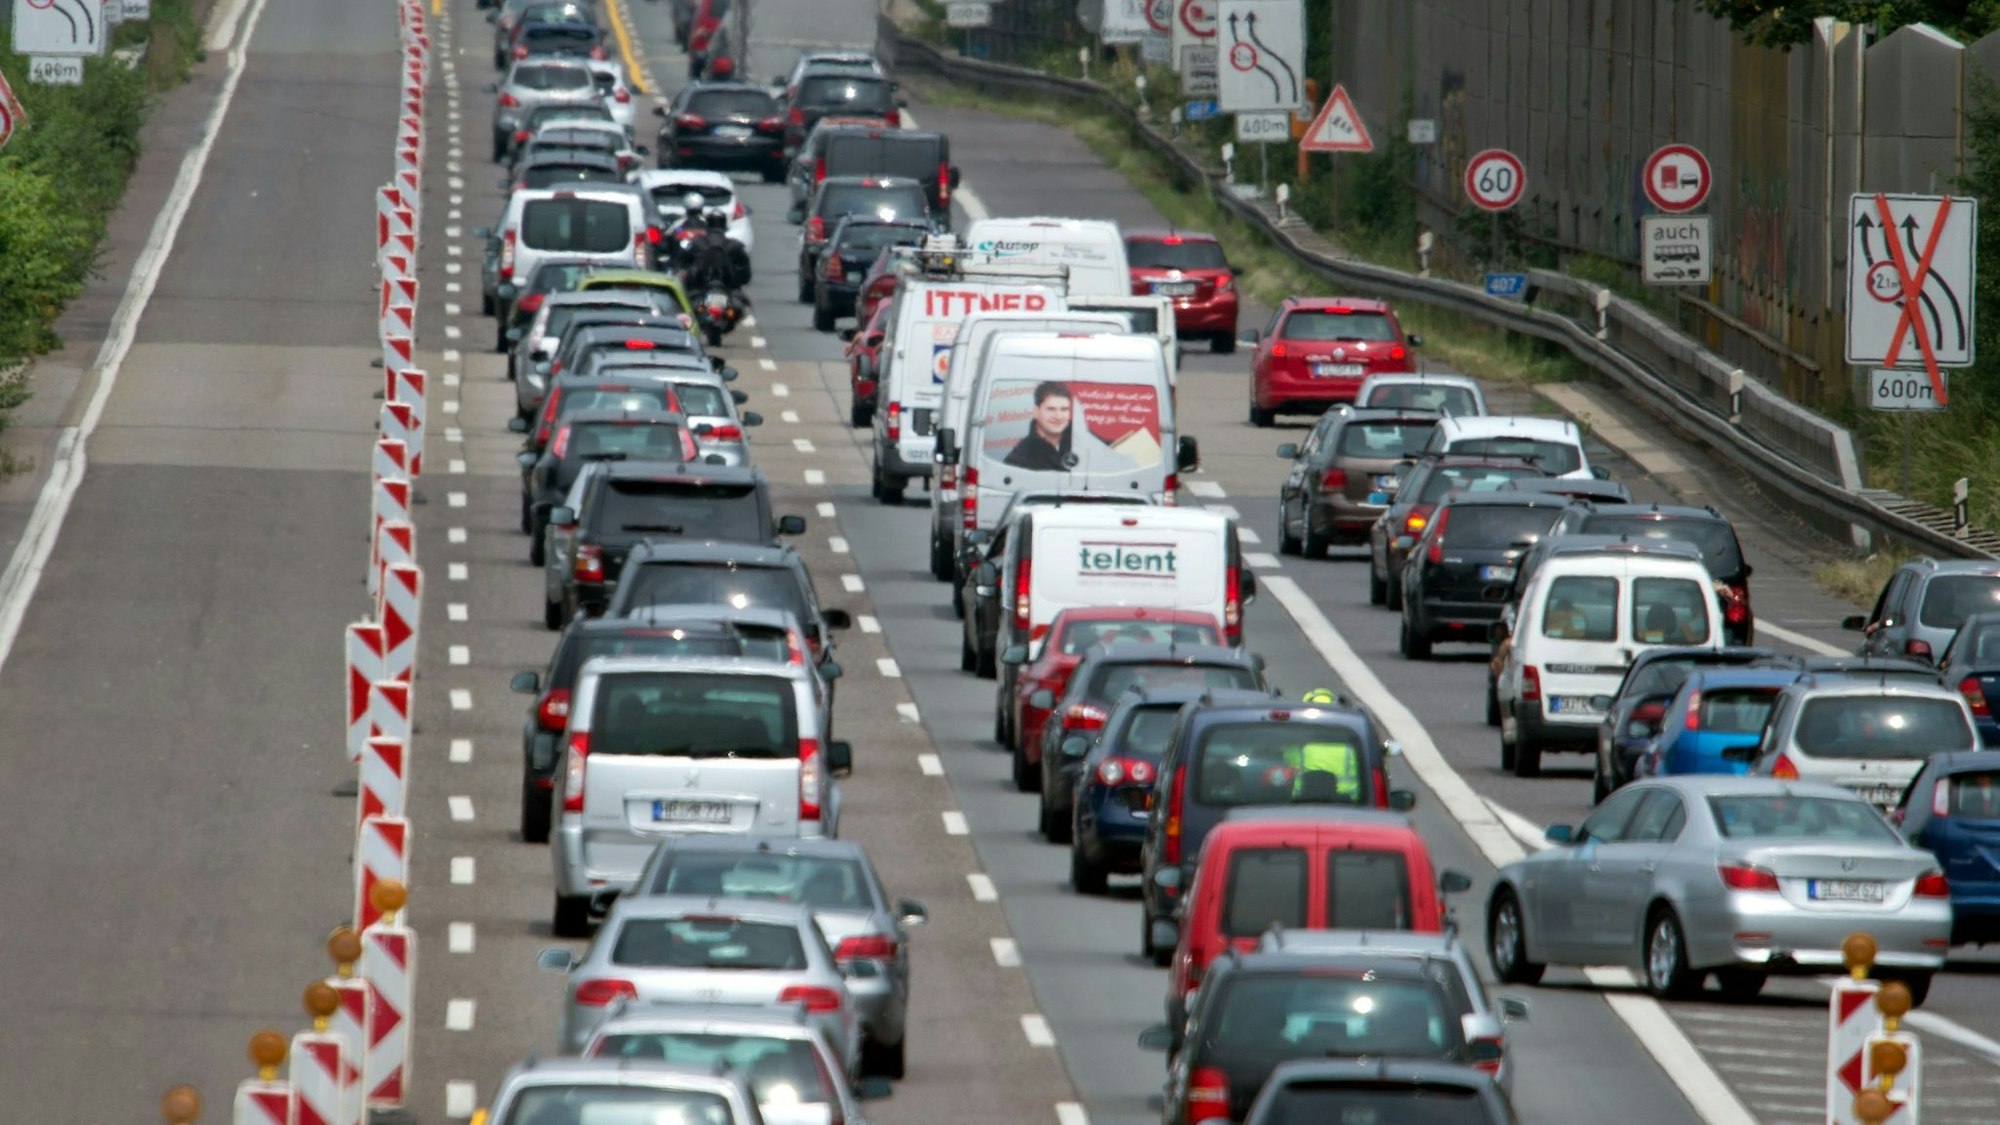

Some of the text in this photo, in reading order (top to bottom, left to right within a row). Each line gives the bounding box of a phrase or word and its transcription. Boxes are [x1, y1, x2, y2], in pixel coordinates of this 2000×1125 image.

[1242, 119, 1287, 134] 400m
[1480, 167, 1512, 193] 60
[1653, 222, 1700, 241] auch
[1489, 277, 1517, 292] 407
[1079, 547, 1176, 572] telent
